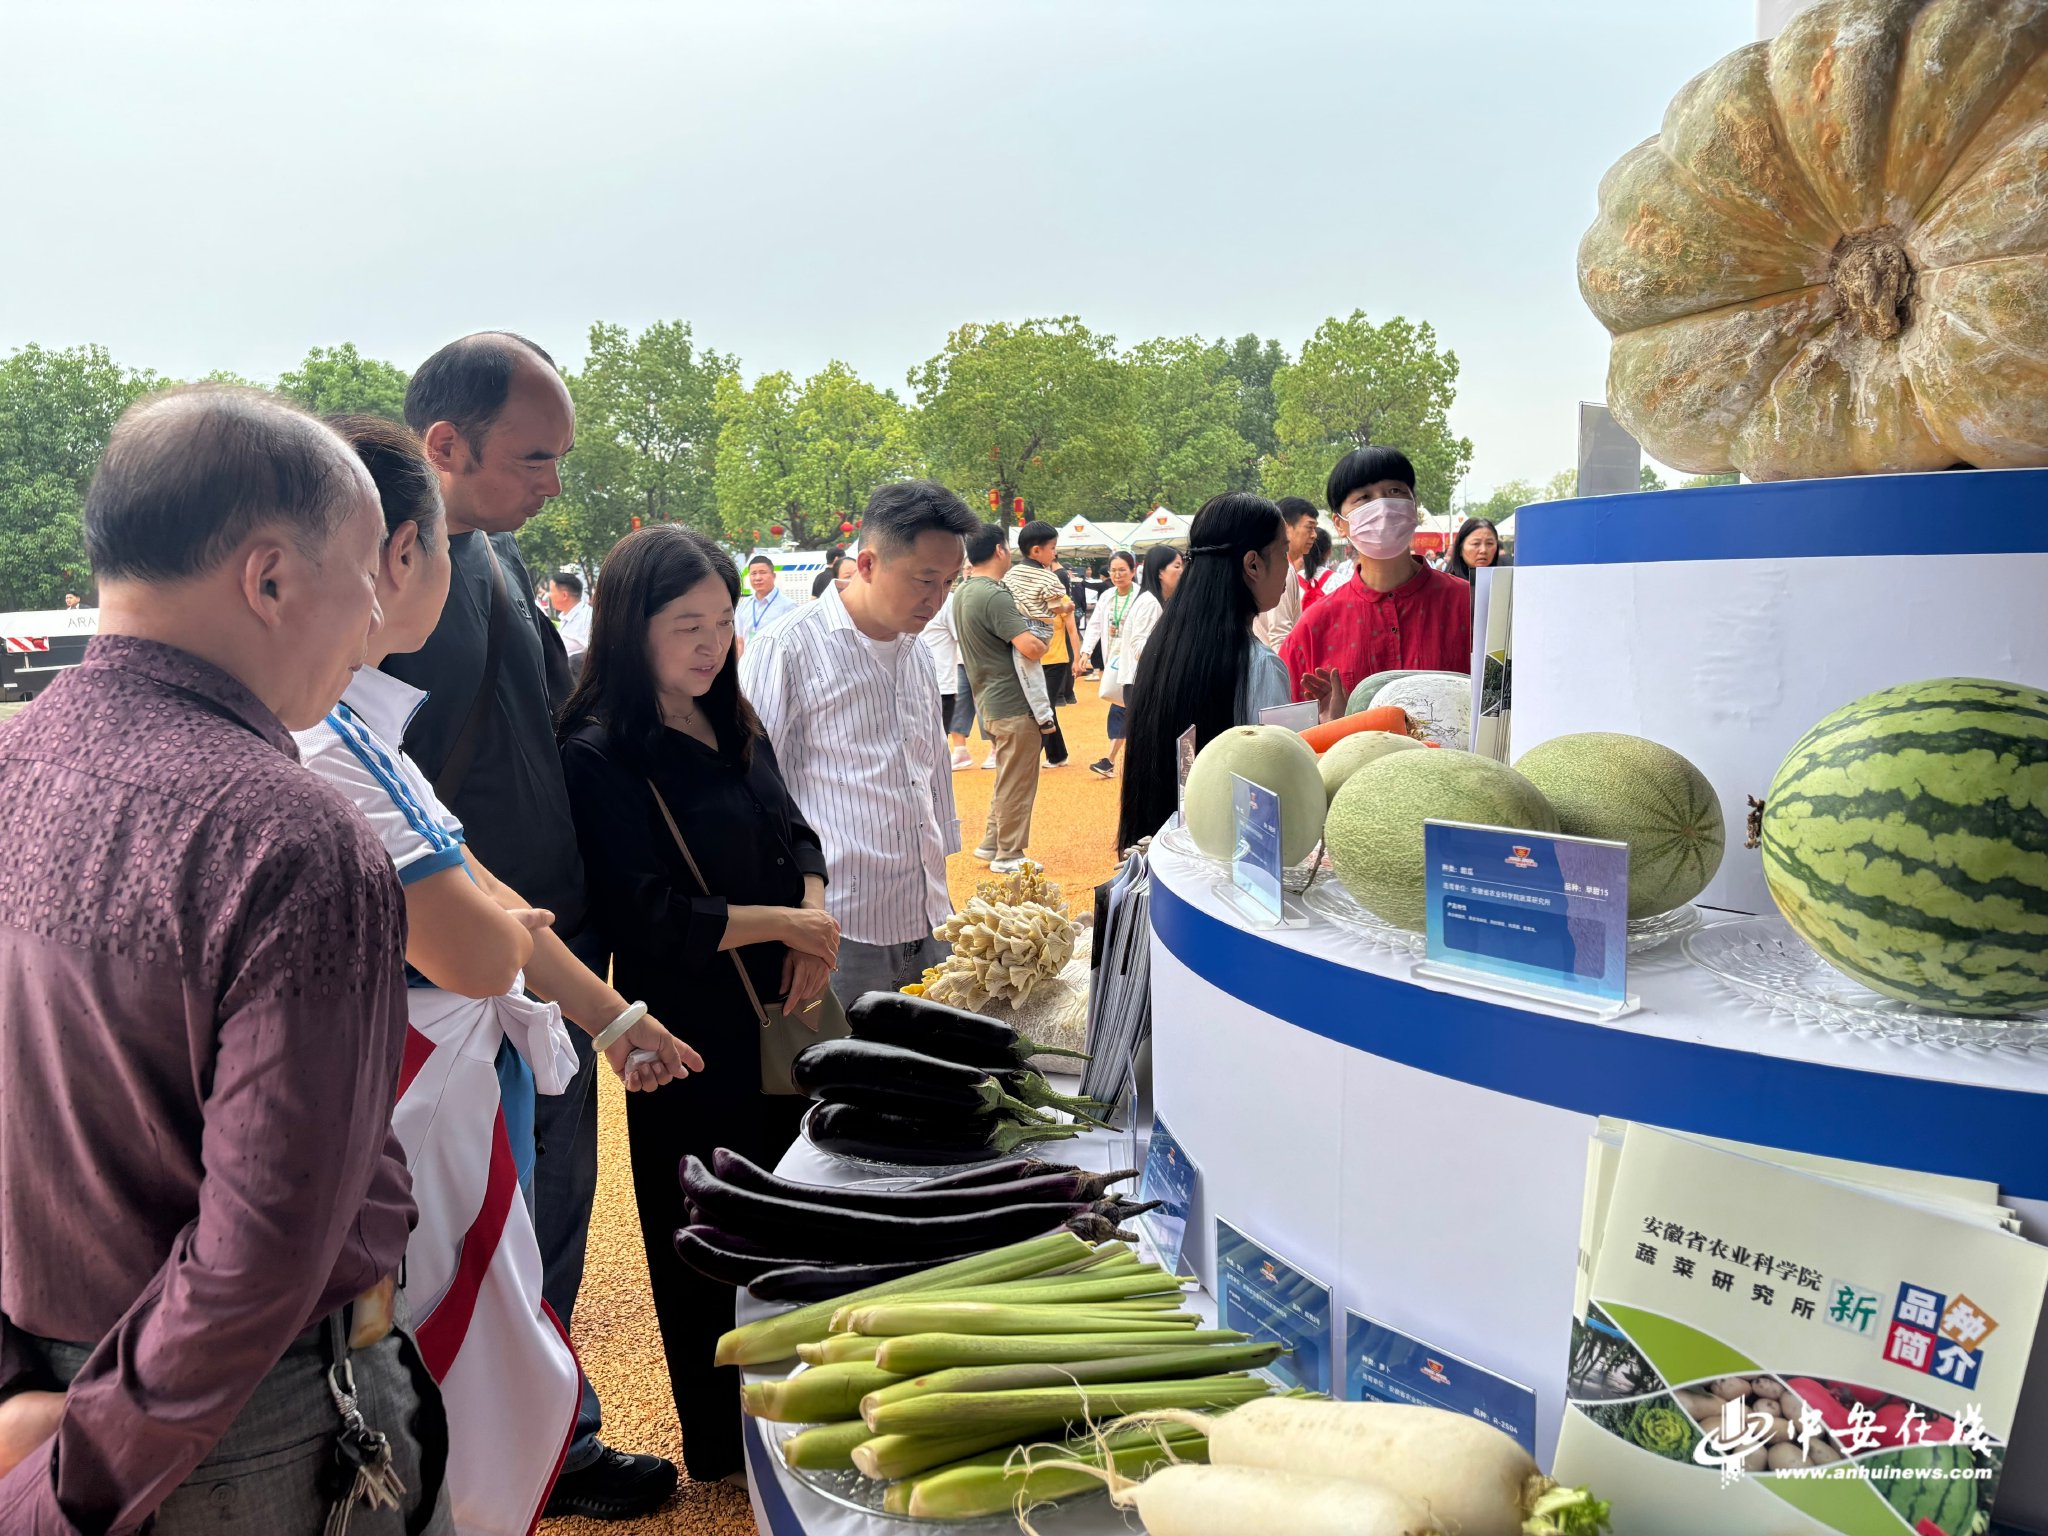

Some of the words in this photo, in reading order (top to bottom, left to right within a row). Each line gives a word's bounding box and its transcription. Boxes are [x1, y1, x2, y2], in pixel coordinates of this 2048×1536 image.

[1635, 1242, 1815, 1320] 蔬菜研究所
[1641, 1216, 1824, 1291] 安徽省农业科学院
[1829, 1285, 1877, 1332] 新
[1898, 1288, 1988, 1342] 品种
[1890, 1326, 1977, 1383] 简介
